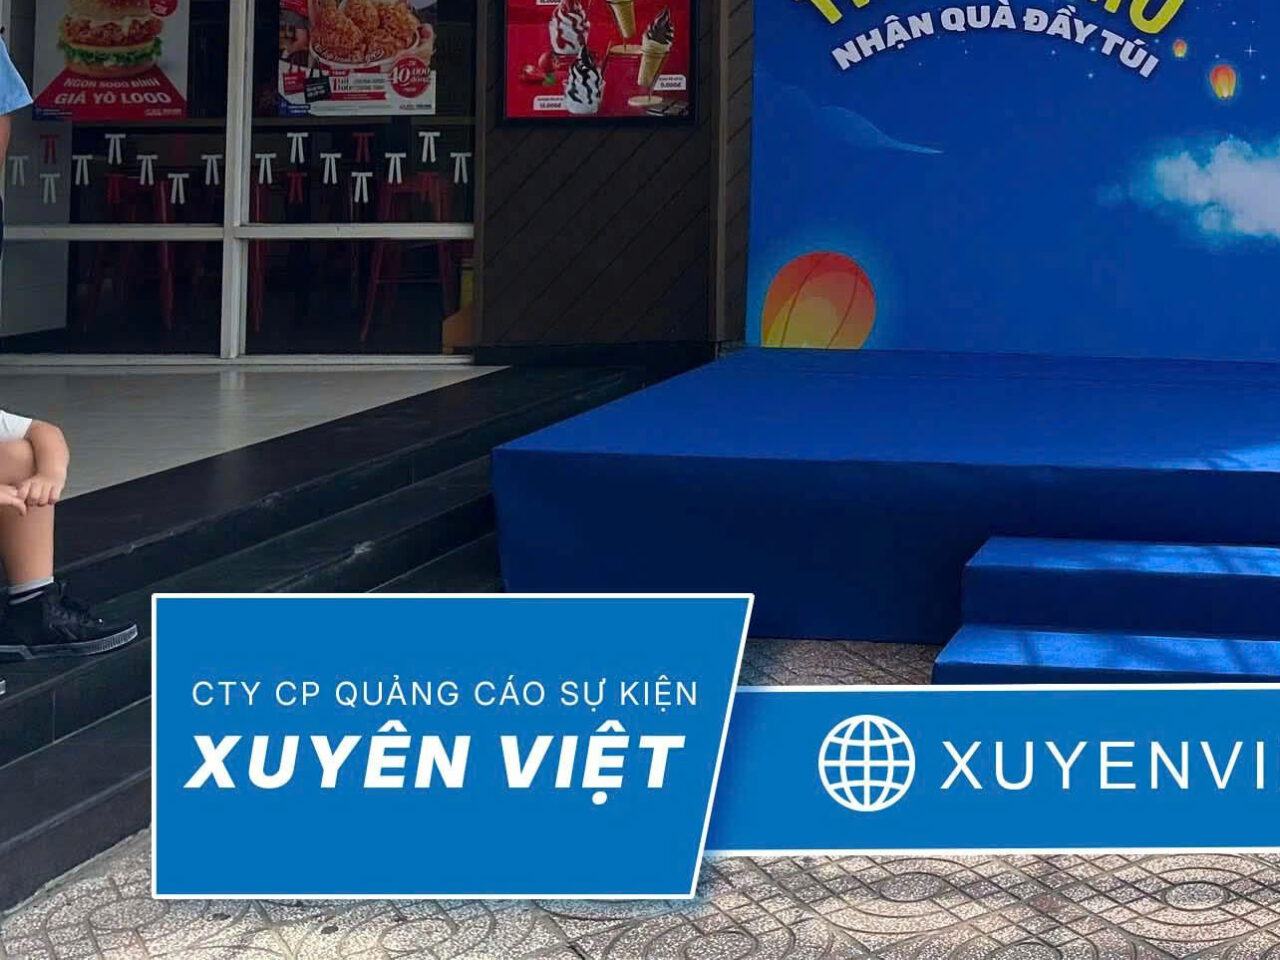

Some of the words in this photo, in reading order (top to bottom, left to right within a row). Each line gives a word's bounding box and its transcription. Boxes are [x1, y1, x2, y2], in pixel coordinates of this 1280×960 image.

[831, 10, 934, 71] NHẬN
[1022, 5, 1098, 44] ĐẦY
[1100, 29, 1159, 79] TÚI
[54, 91, 86, 104] GIÁ
